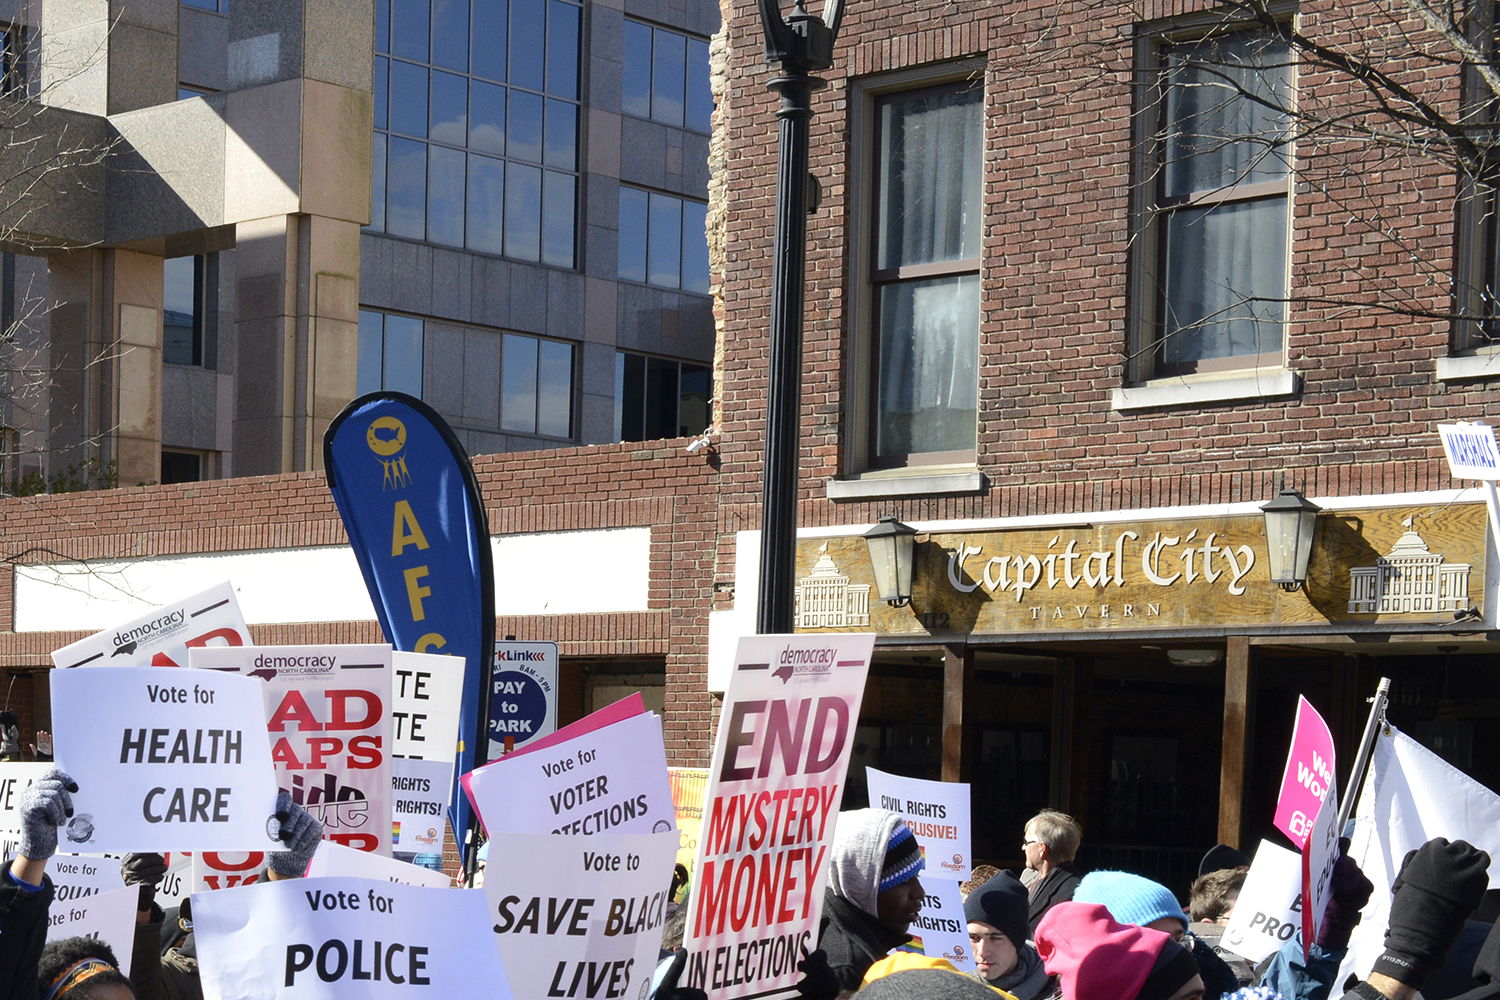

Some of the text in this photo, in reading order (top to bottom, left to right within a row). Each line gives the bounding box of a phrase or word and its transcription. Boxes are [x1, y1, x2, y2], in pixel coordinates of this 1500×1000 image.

[1446, 433, 1496, 468] MARSHALS
[947, 529, 1256, 600] Capital City
[1029, 602, 1162, 620] TAVERN
[113, 608, 185, 647] democracy
[137, 634, 156, 644] NORTH
[156, 622, 182, 636] CAROLINA
[254, 653, 336, 670] democracy
[780, 644, 838, 668] democracy
[493, 664, 502, 672] RI
[519, 664, 536, 677] 8AM
[539, 677, 551, 693] 5PM
[494, 681, 526, 694] PAY
[146, 684, 214, 704] Vote for
[501, 701, 518, 713] to
[267, 689, 383, 732] AD
[489, 719, 532, 733] PARK
[719, 696, 850, 782] END
[119, 728, 242, 765] HEALTH
[273, 735, 383, 770] APS
[542, 749, 597, 778] Vote for
[392, 777, 431, 792] RIGHTS
[550, 775, 609, 815] VOTER
[143, 787, 231, 824] CARE
[396, 800, 442, 816] RIGHTS!
[881, 795, 946, 819] CIVIL RIGHTS
[705, 784, 838, 857] MYSTERY
[904, 820, 957, 840] CLUSIVE!
[56, 863, 97, 876] Vote for
[583, 851, 640, 872] Vote to
[941, 862, 966, 870] Freedom
[304, 889, 394, 914] Vote for
[693, 845, 826, 939] MONEY
[48, 908, 88, 927] ote for
[493, 889, 668, 937] SAVE BLACK
[284, 938, 431, 988] POLICE
[687, 930, 811, 994] IN ELECTIONS
[547, 957, 635, 999] LIVES
